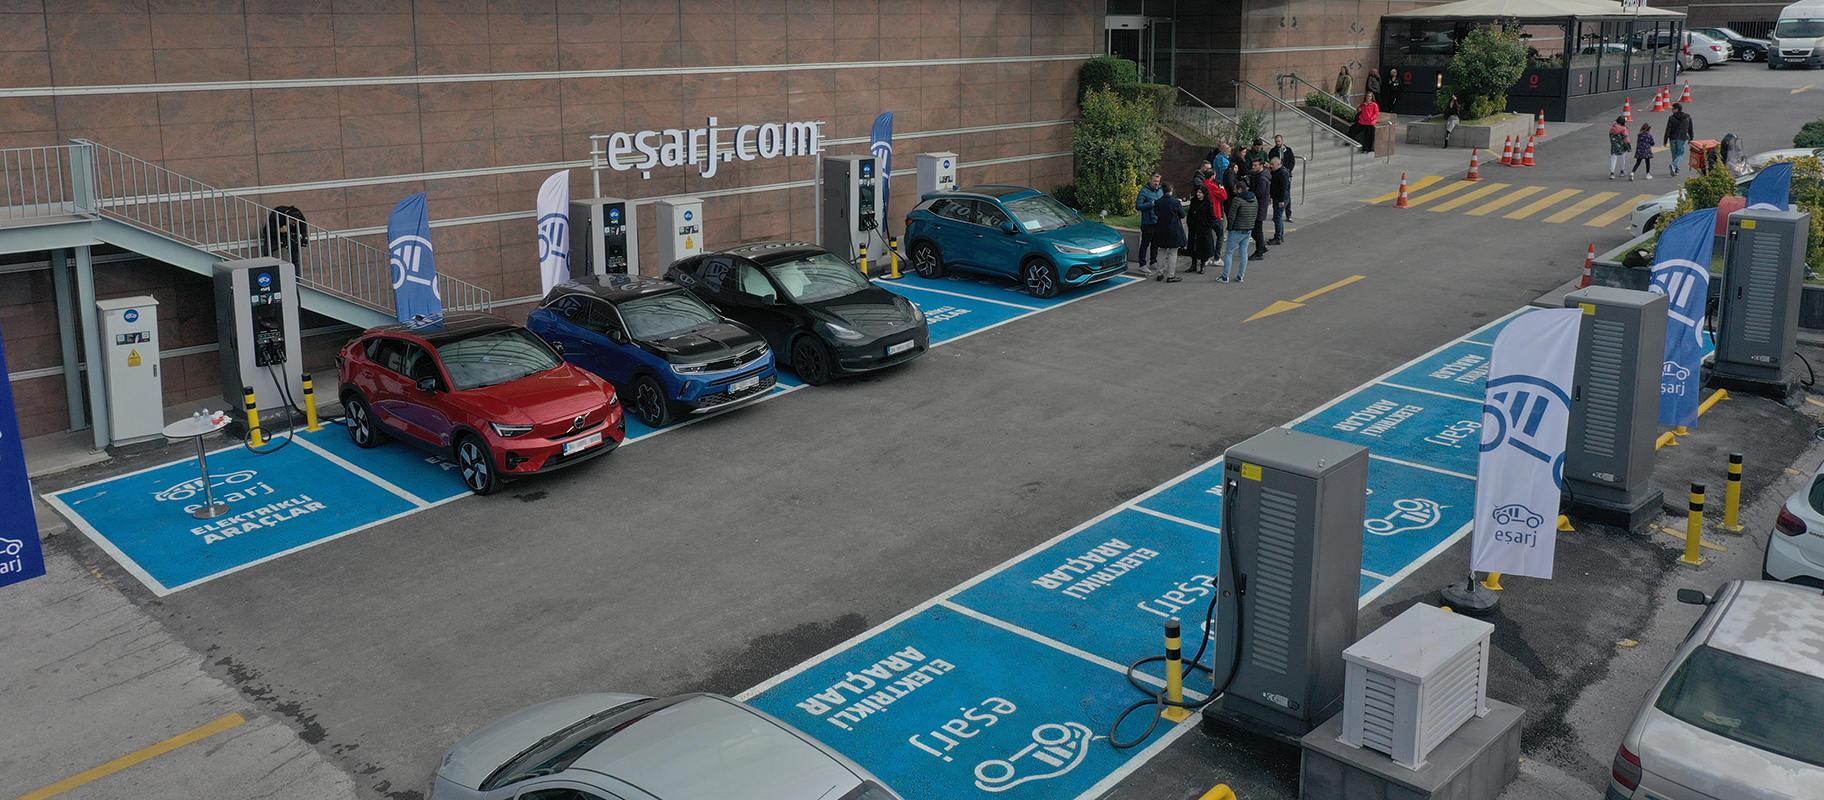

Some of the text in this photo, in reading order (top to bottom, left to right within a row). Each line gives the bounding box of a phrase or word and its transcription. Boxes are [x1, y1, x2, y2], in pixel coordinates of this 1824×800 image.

[607, 116, 819, 180] eşarj.com
[1428, 353, 1486, 379] ARAÇLAR
[1660, 381, 1686, 397] şarj
[1332, 399, 1400, 432] ARAÇLAR
[1359, 404, 1425, 438] ELEKTRİKLİ
[1423, 420, 1482, 449] eşarj
[190, 493, 314, 536] ELEKTRİKLİ
[203, 501, 328, 545] ARAÇLAR
[1495, 530, 1537, 548] eşarj
[0, 554, 23, 575] arj
[1031, 537, 1132, 590] ARAÇLAR
[1061, 547, 1161, 601] ELEKTRİKLİ
[796, 645, 927, 716] ARAÇLAR
[827, 658, 957, 732] ELEKTRİKLİ
[908, 696, 1018, 763] eşarj
